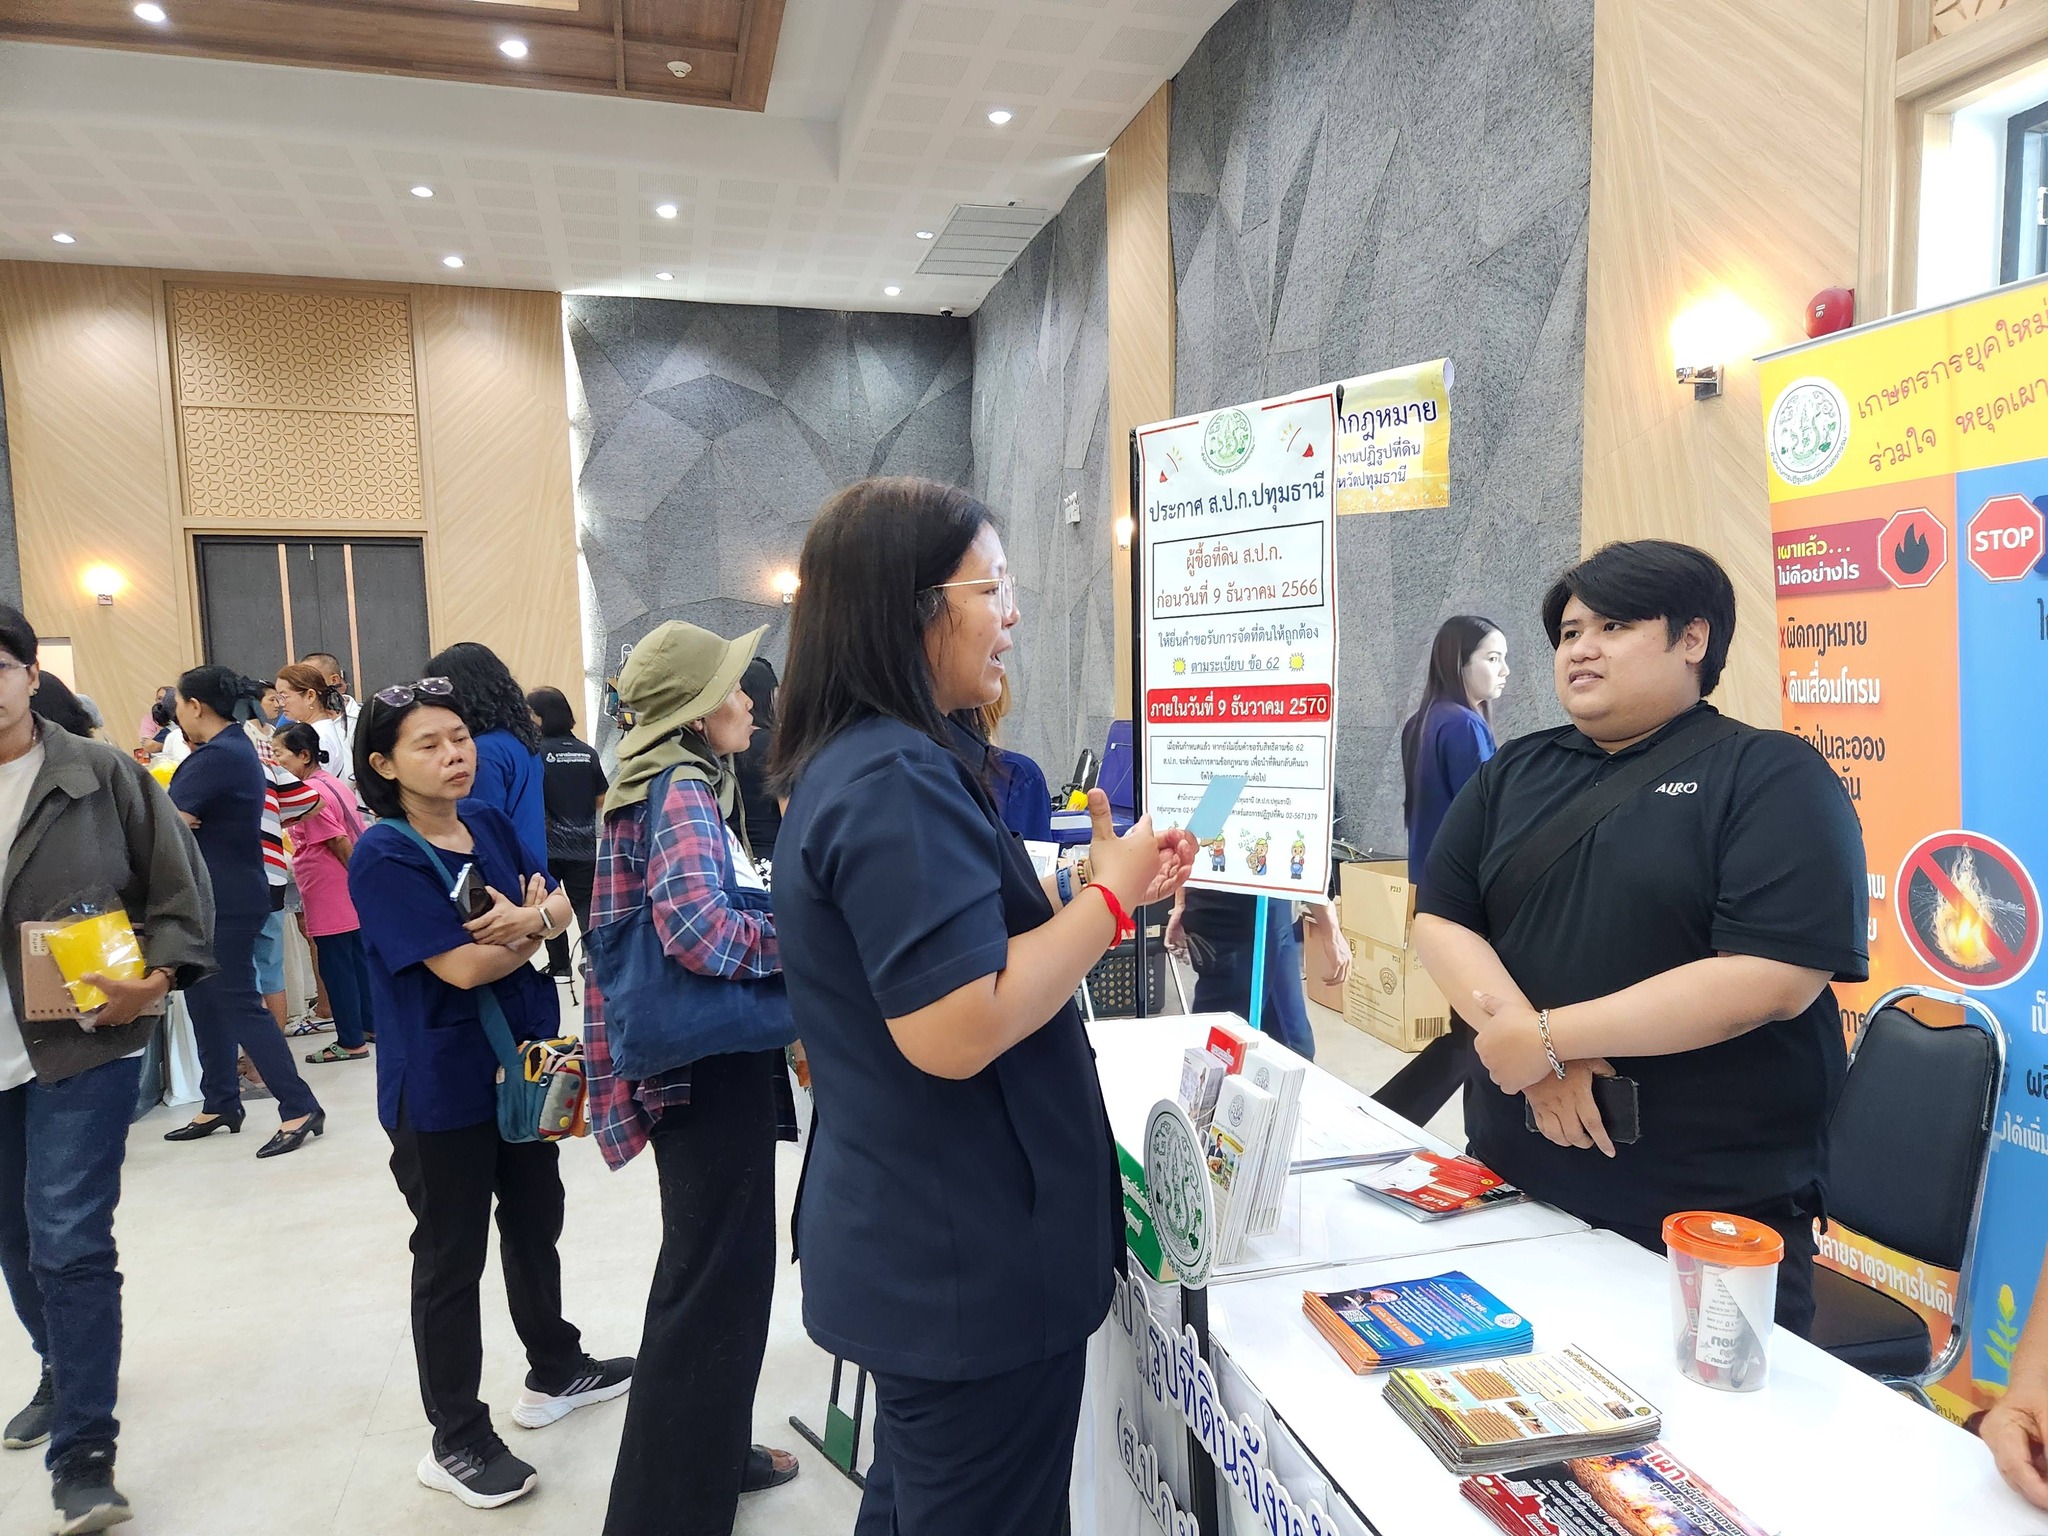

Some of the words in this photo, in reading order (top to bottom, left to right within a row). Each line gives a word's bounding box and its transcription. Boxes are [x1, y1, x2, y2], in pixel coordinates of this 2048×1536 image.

[1868, 427, 1937, 471] ร่วมใจ
[1955, 379, 2048, 434] หยุดเผา
[1149, 498, 1204, 523] ประกาศ
[1209, 470, 1325, 514] ส.ป.ก.ปทุมธานี
[1975, 526, 2034, 552] STOP
[1243, 542, 1283, 564] ส.ป.ก.
[1777, 558, 1860, 587] ไม่ดีอย่างไร
[1156, 580, 1209, 609] ก่อนวันที่
[1213, 586, 1221, 604] 9
[1226, 581, 1276, 603] ธันวาคม
[1281, 578, 1318, 597] 2566
[1158, 622, 1319, 649] ให้ยื่นคำขอรับการจัดที่ดินให้ถูกต้อง
[1191, 656, 1245, 673] ตามระเบียบ
[1248, 655, 1262, 671] ข้อ
[1266, 656, 1280, 670] 62
[1789, 660, 1881, 704] ดินเสื่อมโทรม
[1150, 691, 1214, 718] ภายในวันที่
[1217, 700, 1226, 717] 9
[1231, 694, 1284, 716] ธันวาคม
[1289, 697, 1327, 715] 2570
[1296, 743, 1304, 751] 62
[1654, 782, 1698, 796] ALRO
[1647, 1453, 1686, 1482] เผา
